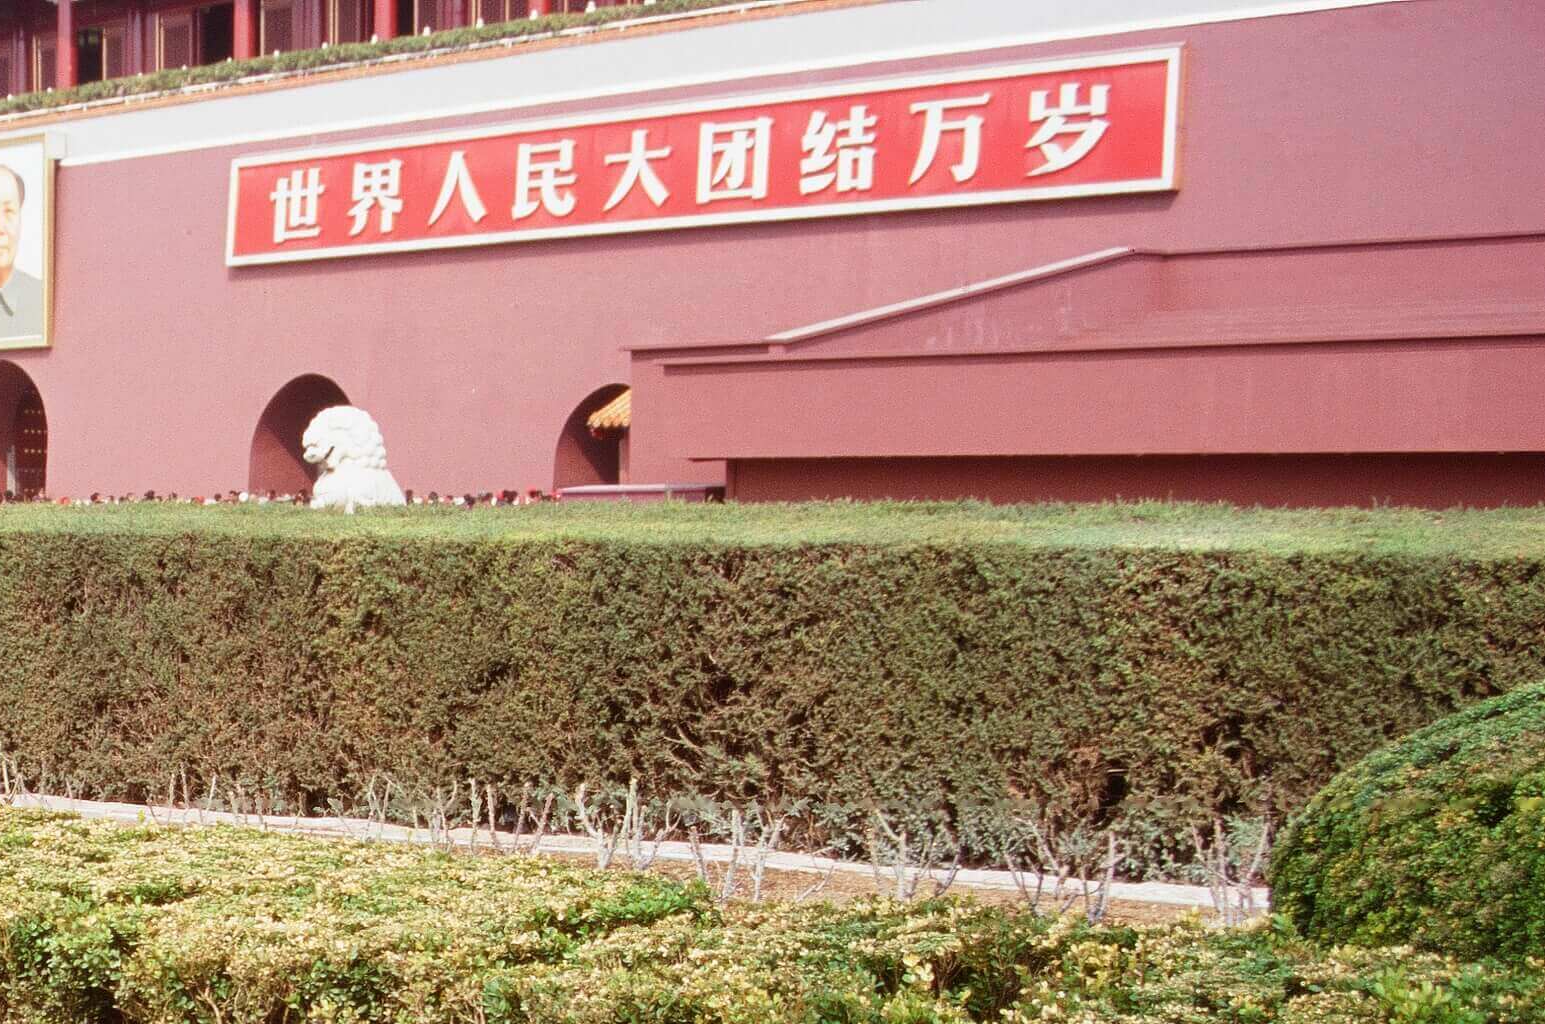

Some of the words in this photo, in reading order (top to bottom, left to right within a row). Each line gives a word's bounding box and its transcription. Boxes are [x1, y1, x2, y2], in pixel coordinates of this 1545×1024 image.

[268, 81, 1109, 244] 世界人民大团结万岁
